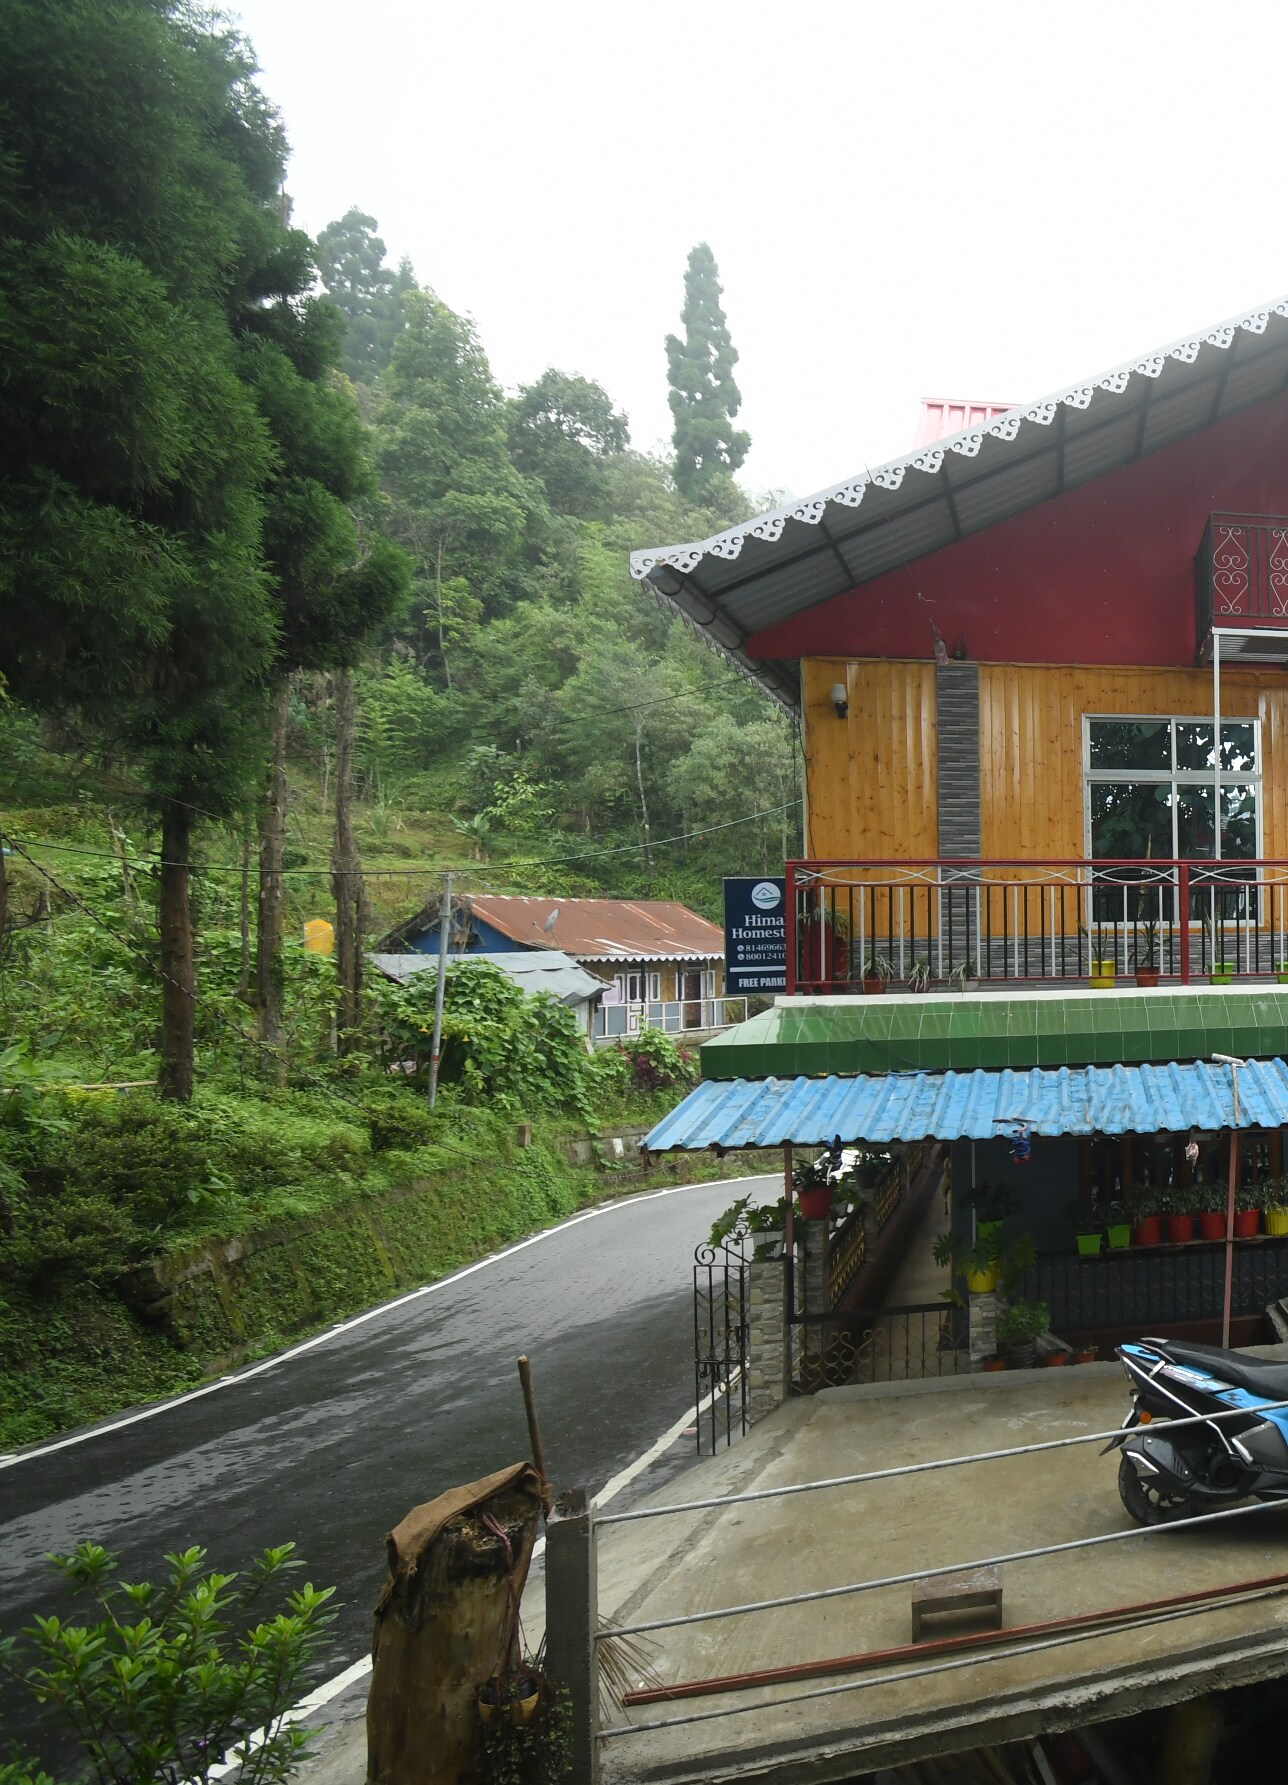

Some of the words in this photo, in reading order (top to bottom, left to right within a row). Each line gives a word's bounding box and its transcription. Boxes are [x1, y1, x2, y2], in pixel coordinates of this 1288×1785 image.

[744, 914, 786, 926] Hima
[732, 927, 786, 939] Homest
[738, 978, 759, 988] FREE
